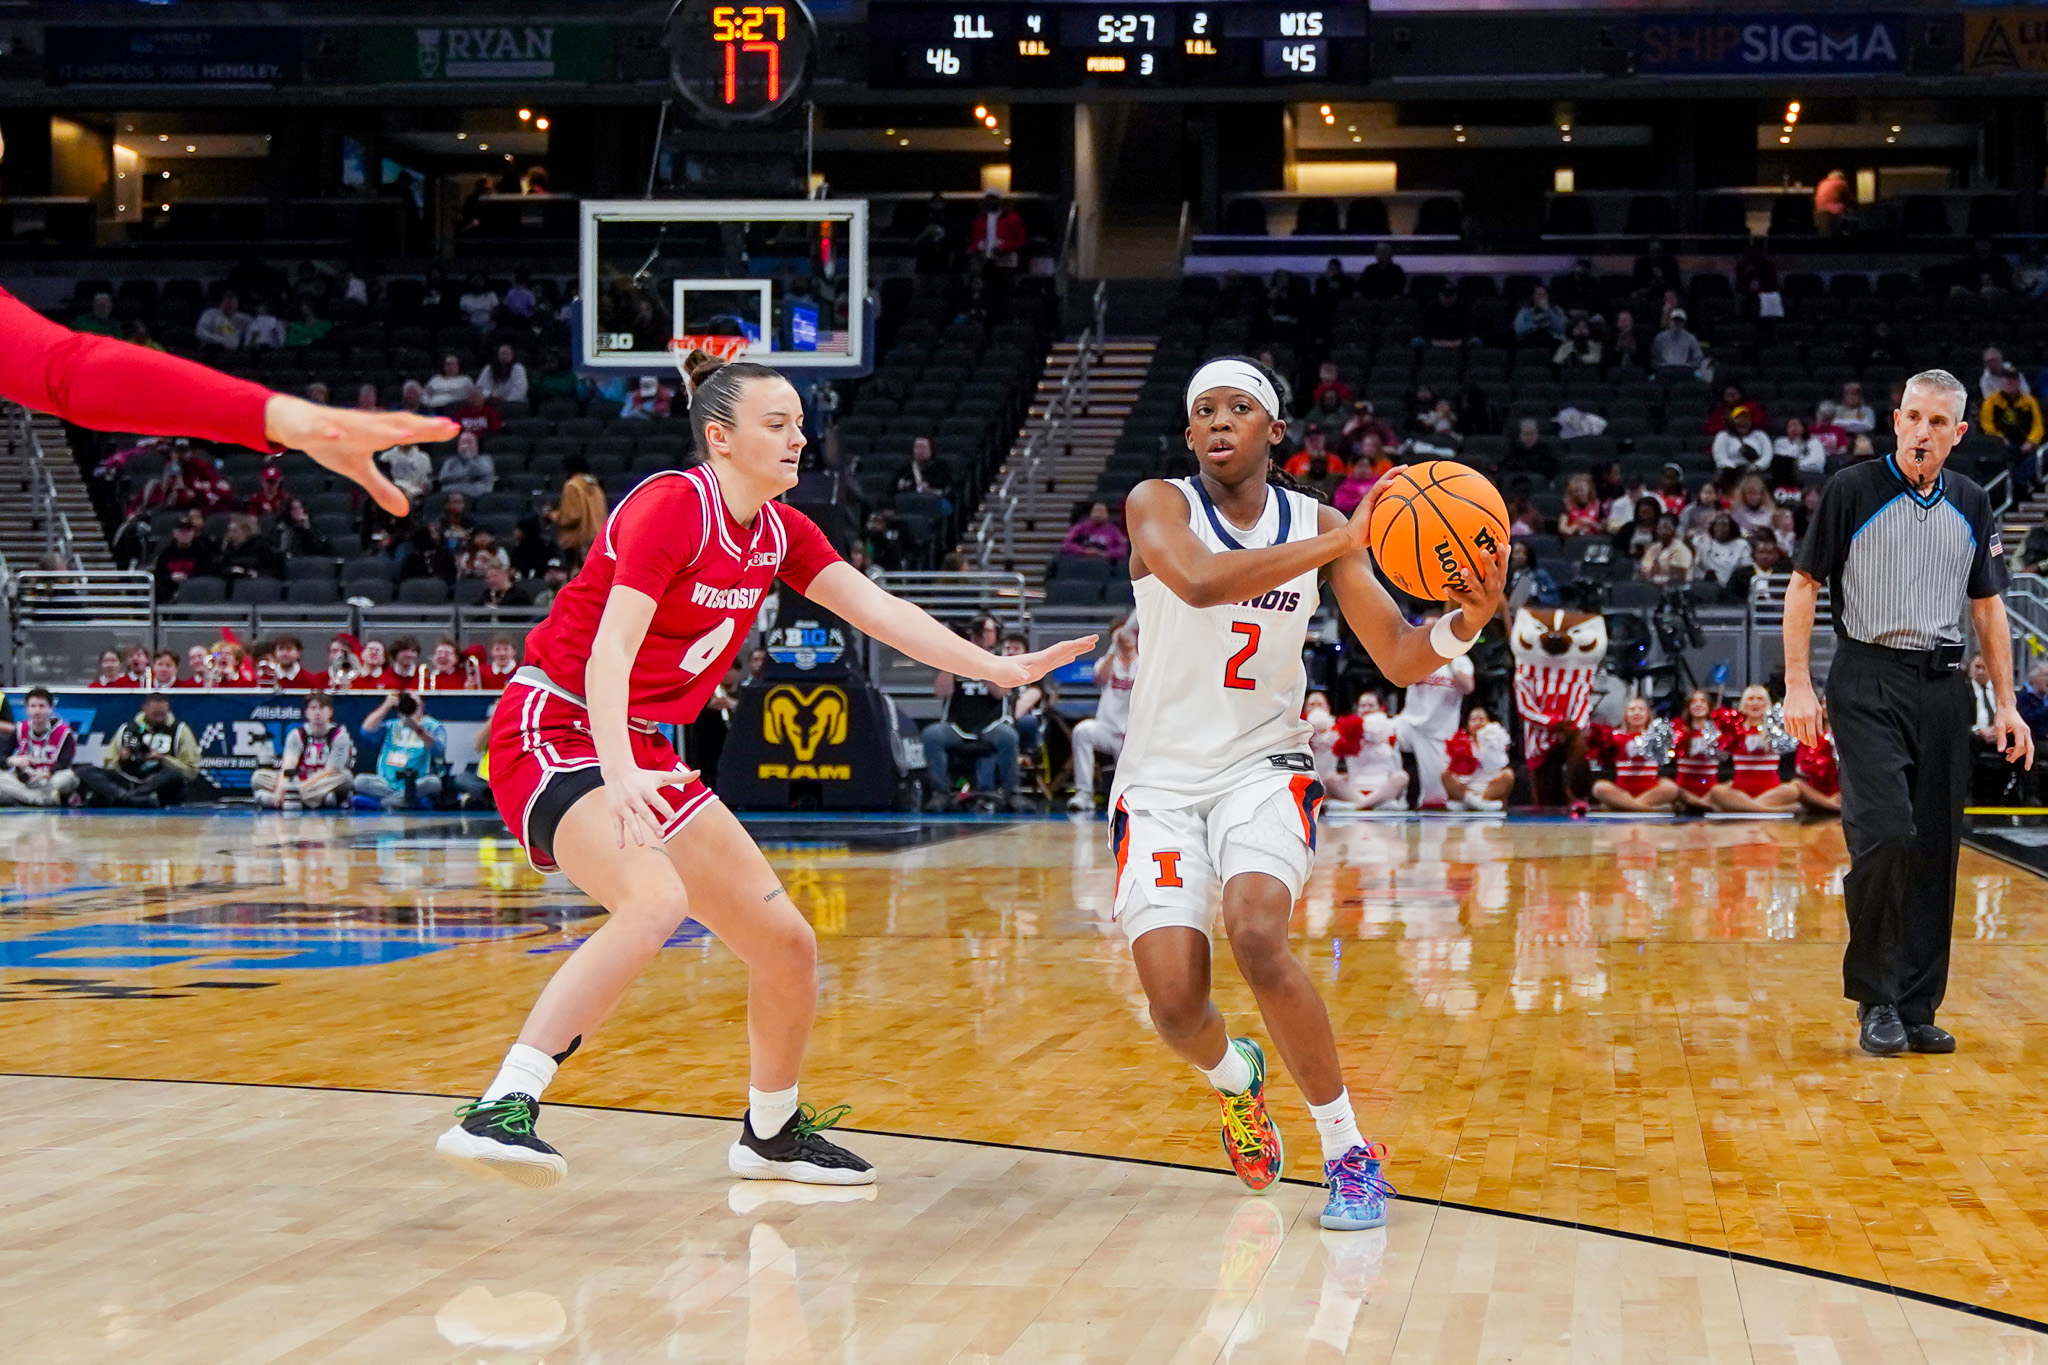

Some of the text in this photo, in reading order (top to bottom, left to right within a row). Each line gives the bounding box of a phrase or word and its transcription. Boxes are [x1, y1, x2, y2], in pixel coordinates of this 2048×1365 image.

[713, 6, 786, 42] 5:27
[953, 14, 994, 39] ILL
[1026, 14, 1042, 34] 4
[1097, 14, 1156, 43] 5:27
[1193, 12, 1208, 34] 2
[1279, 11, 1324, 37] WIS
[447, 27, 555, 59] RYAN
[725, 41, 779, 104] 17
[926, 48, 961, 75] 46
[1140, 53, 1155, 76] 3
[1282, 44, 1317, 73] 45
[678, 616, 736, 678] 4
[1224, 621, 1262, 691] 2
[251, 706, 301, 720] Allstate
[758, 764, 850, 780] RAM
[1152, 851, 1184, 888] I
